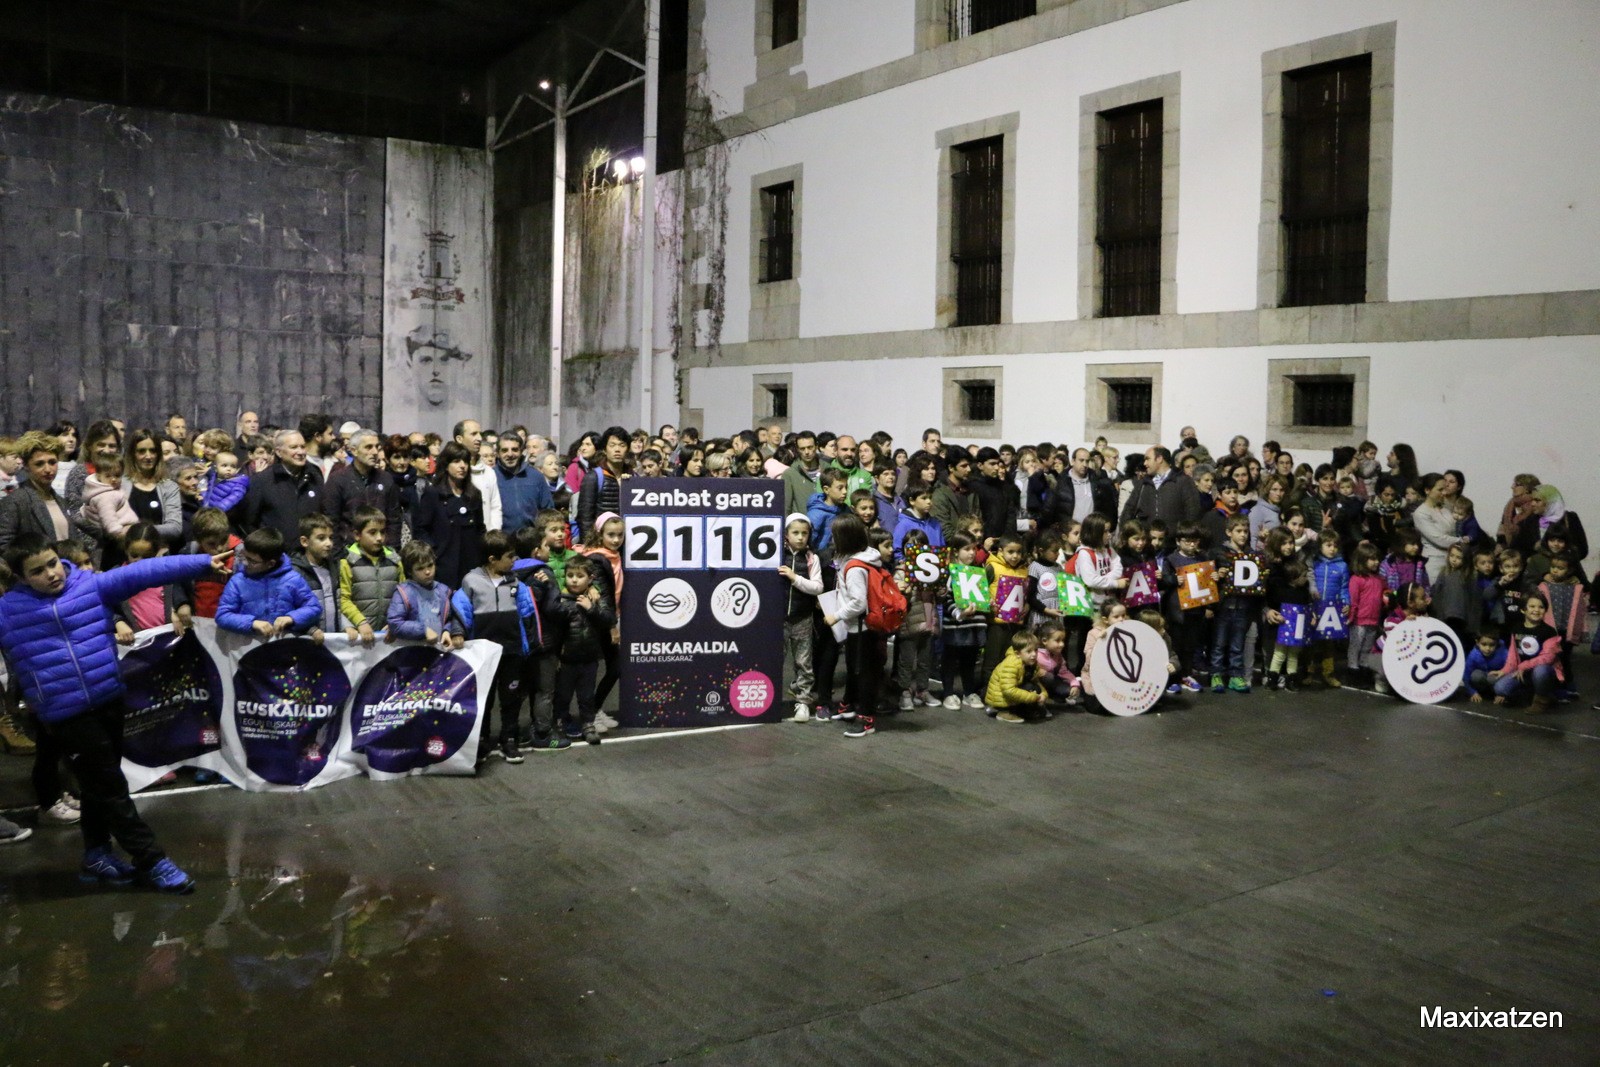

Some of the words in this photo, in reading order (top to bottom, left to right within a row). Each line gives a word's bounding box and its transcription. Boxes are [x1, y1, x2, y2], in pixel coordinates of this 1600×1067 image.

[630, 488, 711, 506] Zenbat
[715, 490, 775, 511] gara?
[630, 524, 777, 561] 2116
[914, 552, 940, 583] S
[1233, 559, 1259, 587] D
[958, 571, 986, 602] K
[1000, 584, 1024, 613] A
[1065, 579, 1090, 608] R
[1125, 570, 1151, 599] A
[1186, 571, 1211, 599] L
[1294, 613, 1305, 640] I
[1316, 606, 1343, 631] A
[630, 640, 739, 655] EUSKARALDIA
[636, 655, 657, 663] EGUN
[657, 654, 694, 663] EUSKARAZ
[736, 684, 768, 701] 365
[739, 700, 765, 709] EGUN
